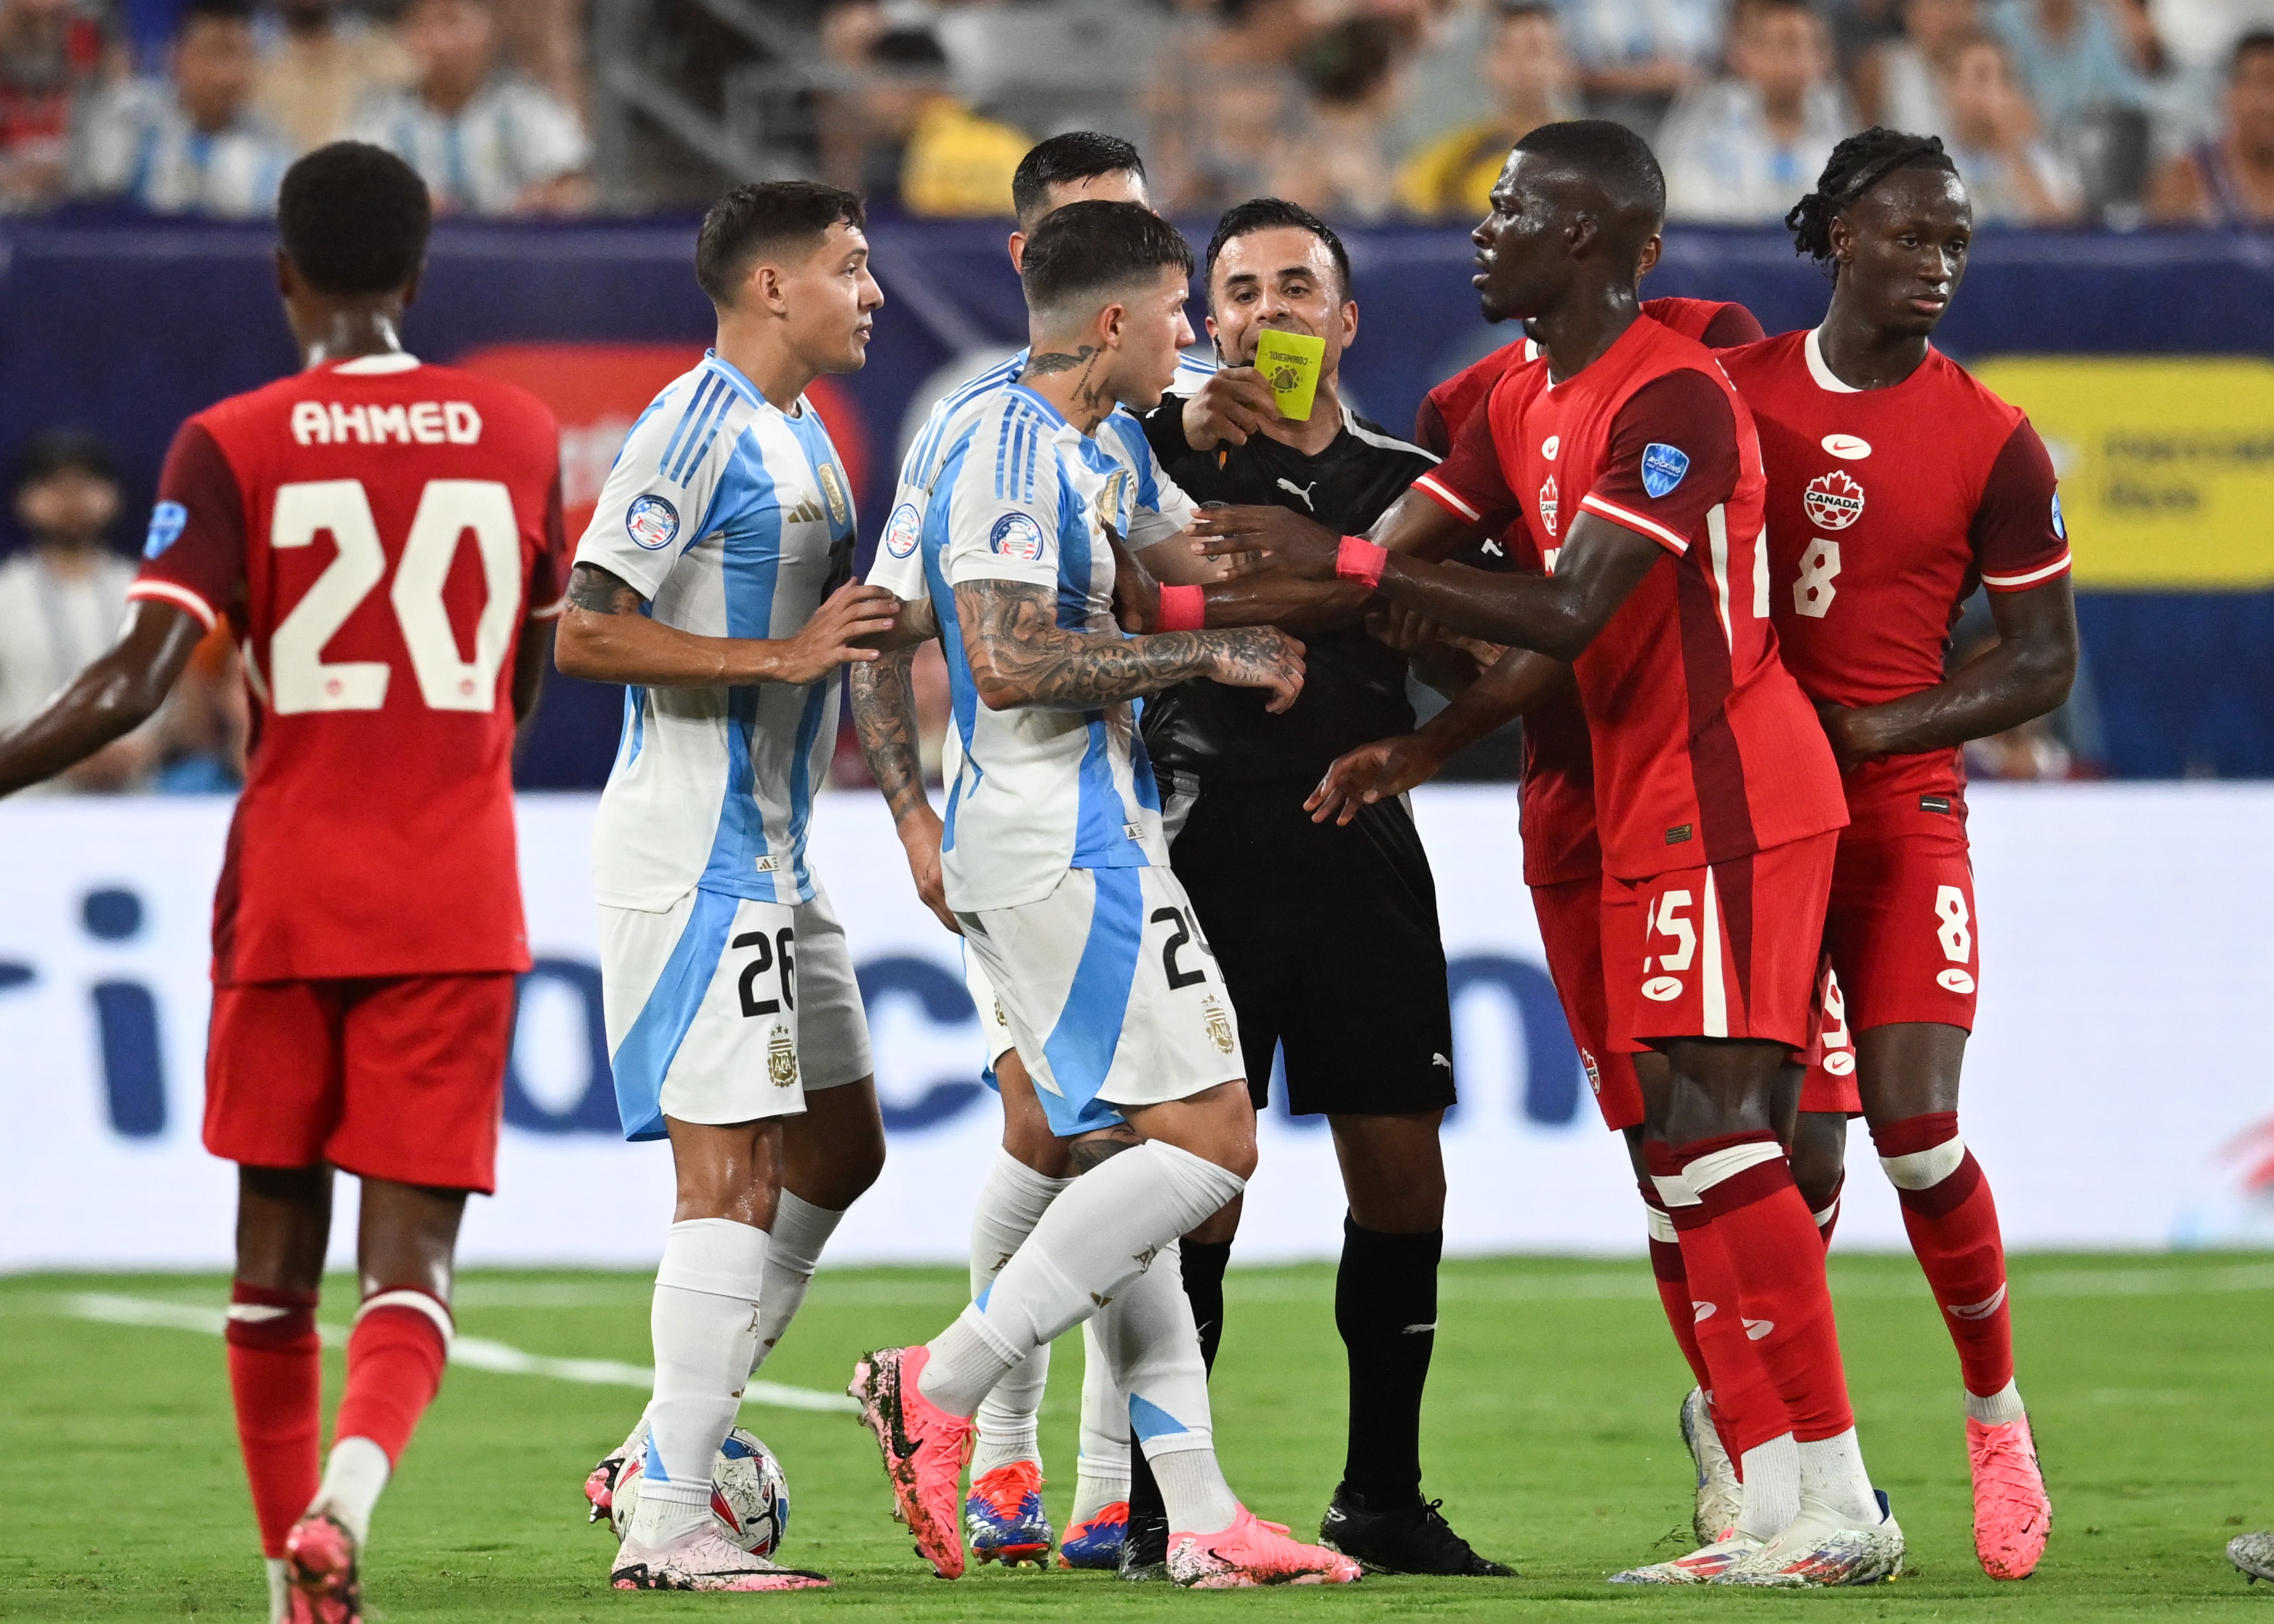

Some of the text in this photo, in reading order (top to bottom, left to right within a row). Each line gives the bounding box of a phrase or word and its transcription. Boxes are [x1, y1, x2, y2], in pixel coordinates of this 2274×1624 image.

[1269, 351, 1309, 365] CONMEBOL
[291, 400, 482, 445] AHMED
[1647, 456, 1681, 474] ROCKING
[1806, 493, 1860, 510] CANADA
[271, 478, 523, 715] 20
[1793, 537, 1841, 618] 8
[1643, 889, 1697, 973] 5
[1934, 885, 1971, 964] 8
[732, 928, 794, 1018] 26
[774, 1052, 792, 1074] AFA
